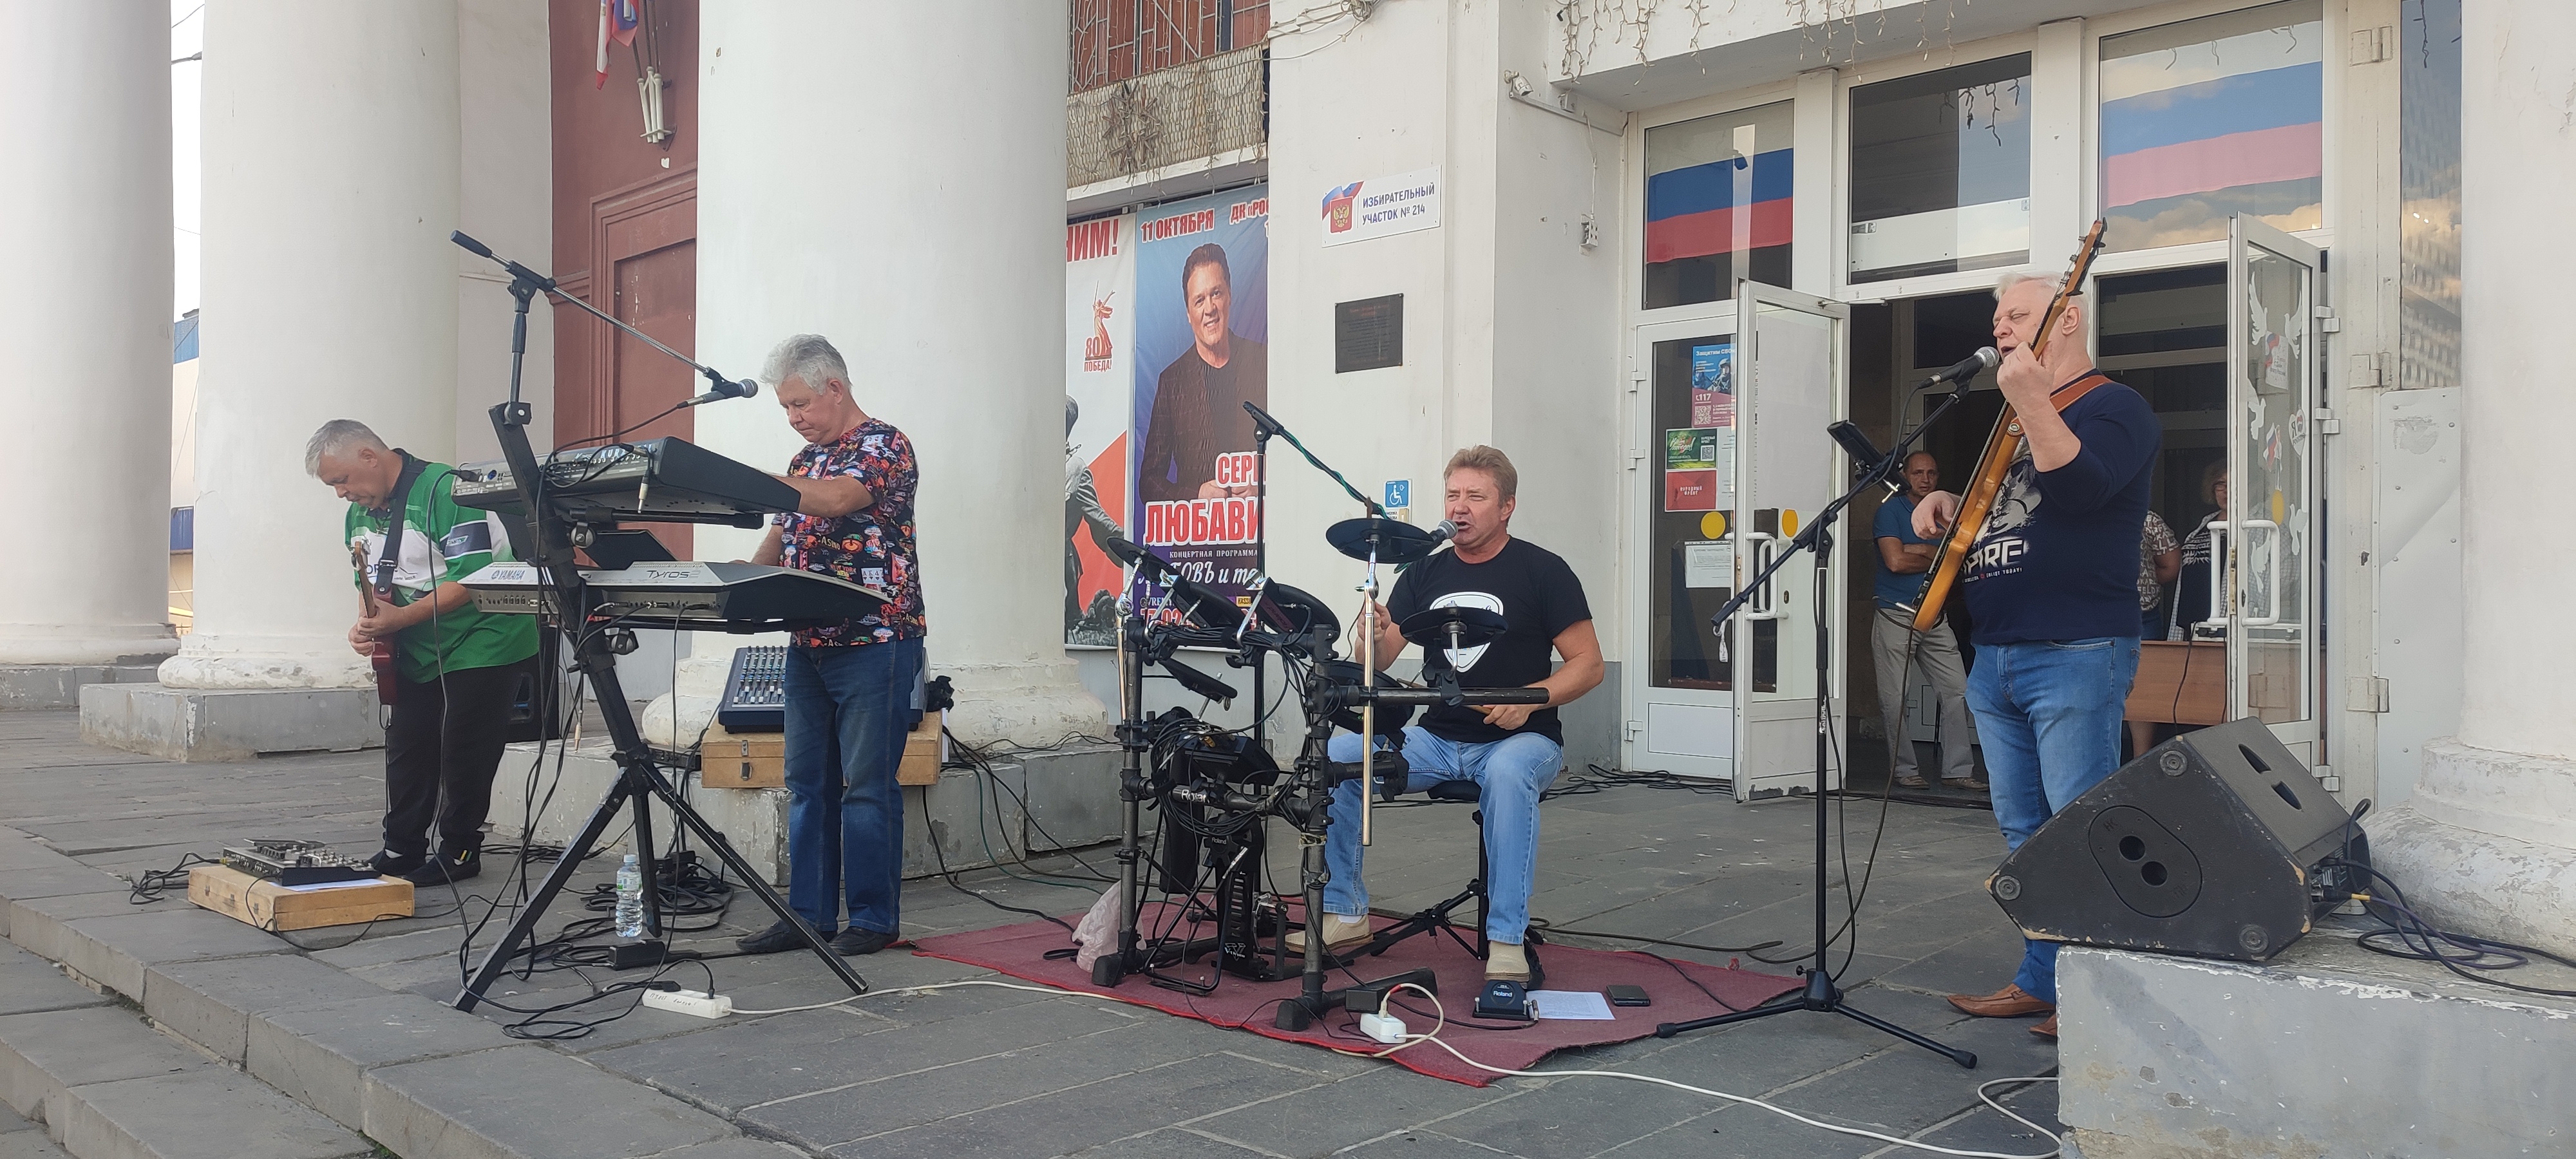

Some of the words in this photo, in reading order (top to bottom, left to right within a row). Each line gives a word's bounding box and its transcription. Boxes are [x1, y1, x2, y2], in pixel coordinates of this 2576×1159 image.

[1363, 182, 1435, 209] ИЗБИРАТЕЛЬНЫЙ
[1231, 203, 1247, 223] ДК
[1362, 208, 1397, 226] УЧАСТОК
[1400, 206, 1410, 218] №
[1412, 203, 1425, 216] 214
[1141, 222, 1153, 242] 11
[1156, 209, 1214, 240] ОКТЯБРЯ
[1085, 336, 1101, 357] 80
[1084, 359, 1112, 372] ПОБЕДА!
[1700, 393, 1711, 401] 117
[1217, 549, 1258, 558] ПРОГРАММА
[1963, 540, 2023, 575] PIRE
[498, 570, 526, 581] YAMAHA
[646, 569, 701, 580] Tyros2
[1211, 836, 1227, 845] Roland
